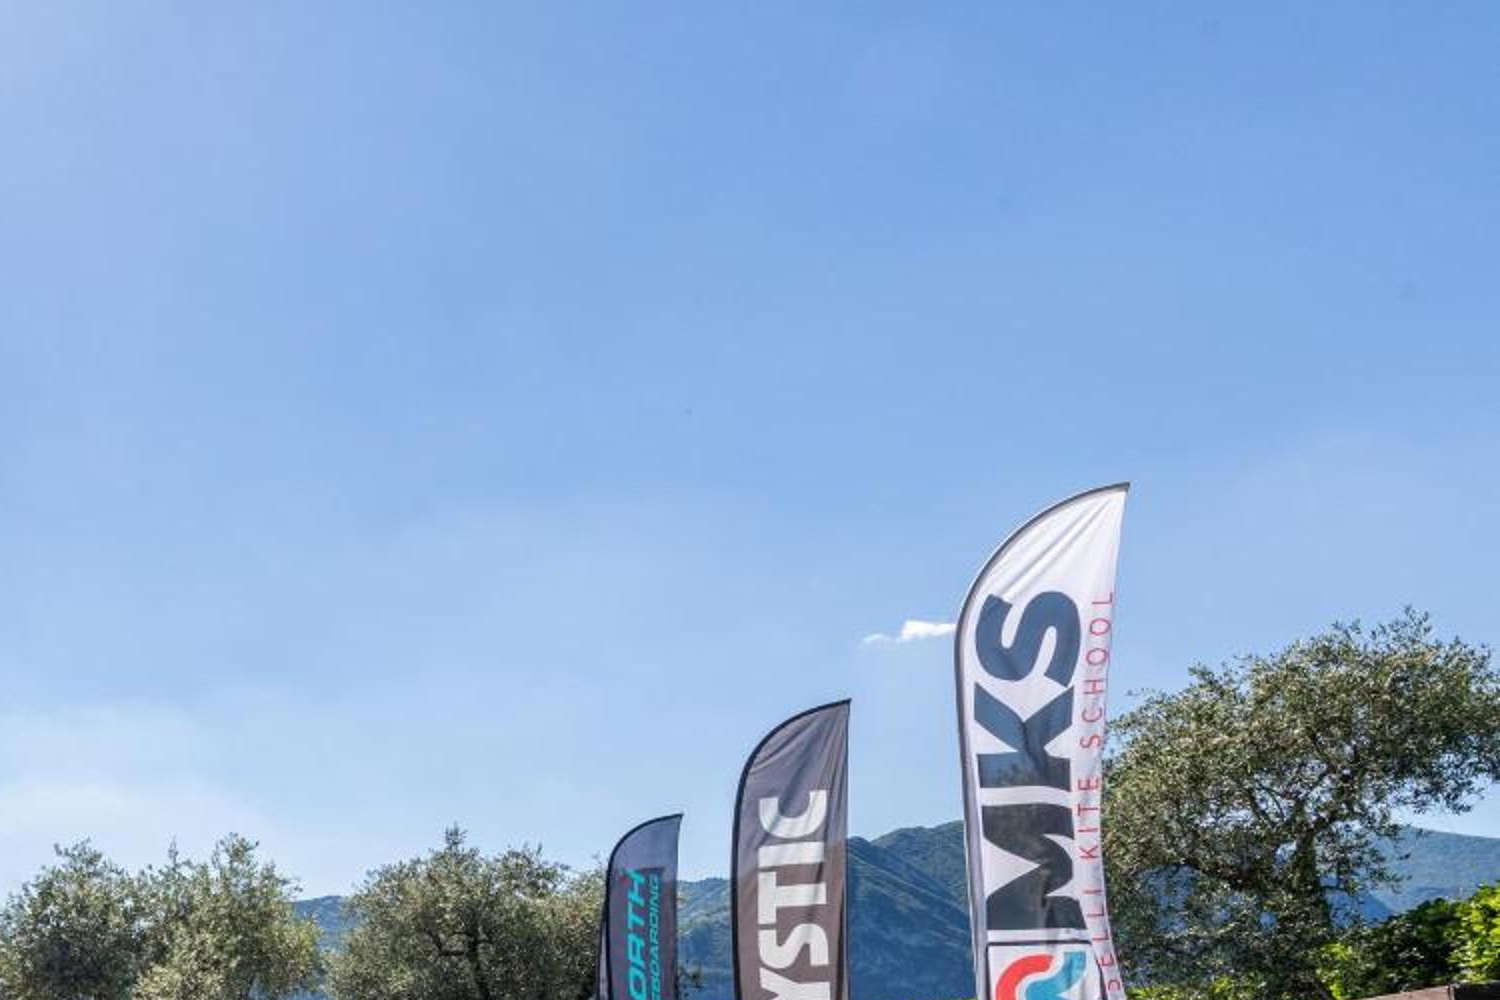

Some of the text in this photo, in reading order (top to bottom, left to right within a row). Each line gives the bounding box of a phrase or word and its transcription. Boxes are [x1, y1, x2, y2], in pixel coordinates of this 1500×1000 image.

[1079, 591, 1114, 749] SCHOOL
[974, 591, 1087, 931] MKS
[1077, 777, 1099, 861] KITE
